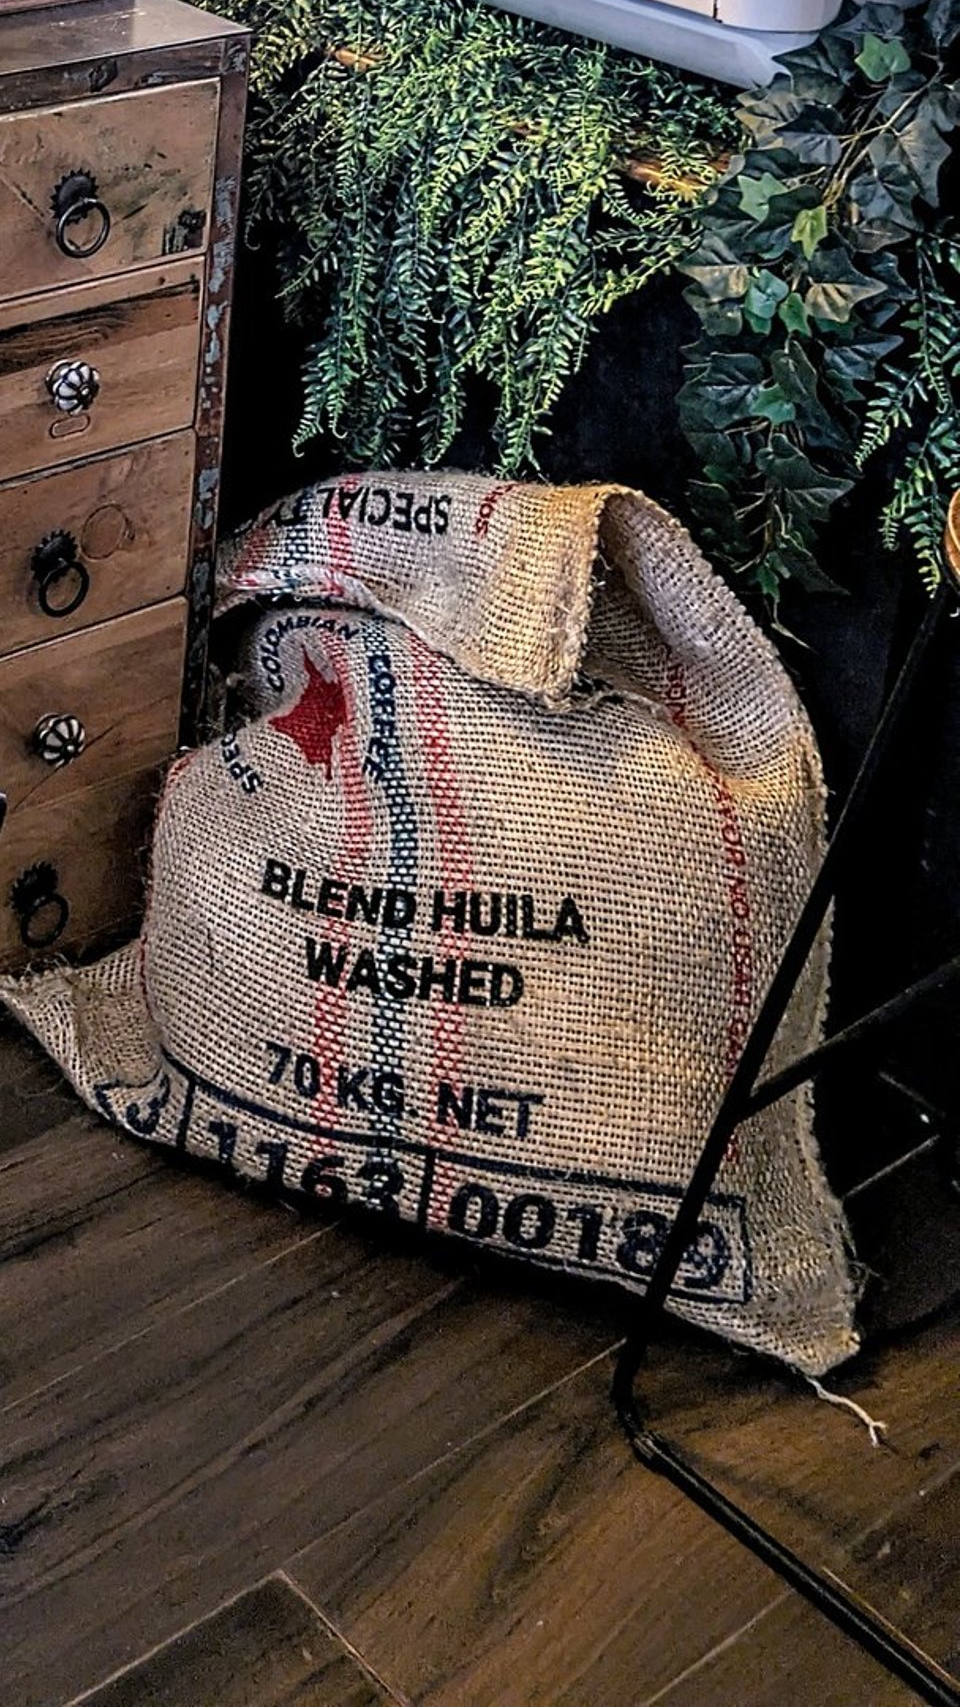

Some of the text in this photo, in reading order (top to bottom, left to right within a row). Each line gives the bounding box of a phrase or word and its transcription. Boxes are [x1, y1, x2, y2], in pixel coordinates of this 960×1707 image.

[260, 614, 360, 693] COLOMBIAN
[361, 654, 398, 786] COFFEE
[262, 858, 590, 946] BLEND HUILA
[304, 936, 526, 1009] WASHED
[264, 1043, 547, 1139] 70 KG. NET
